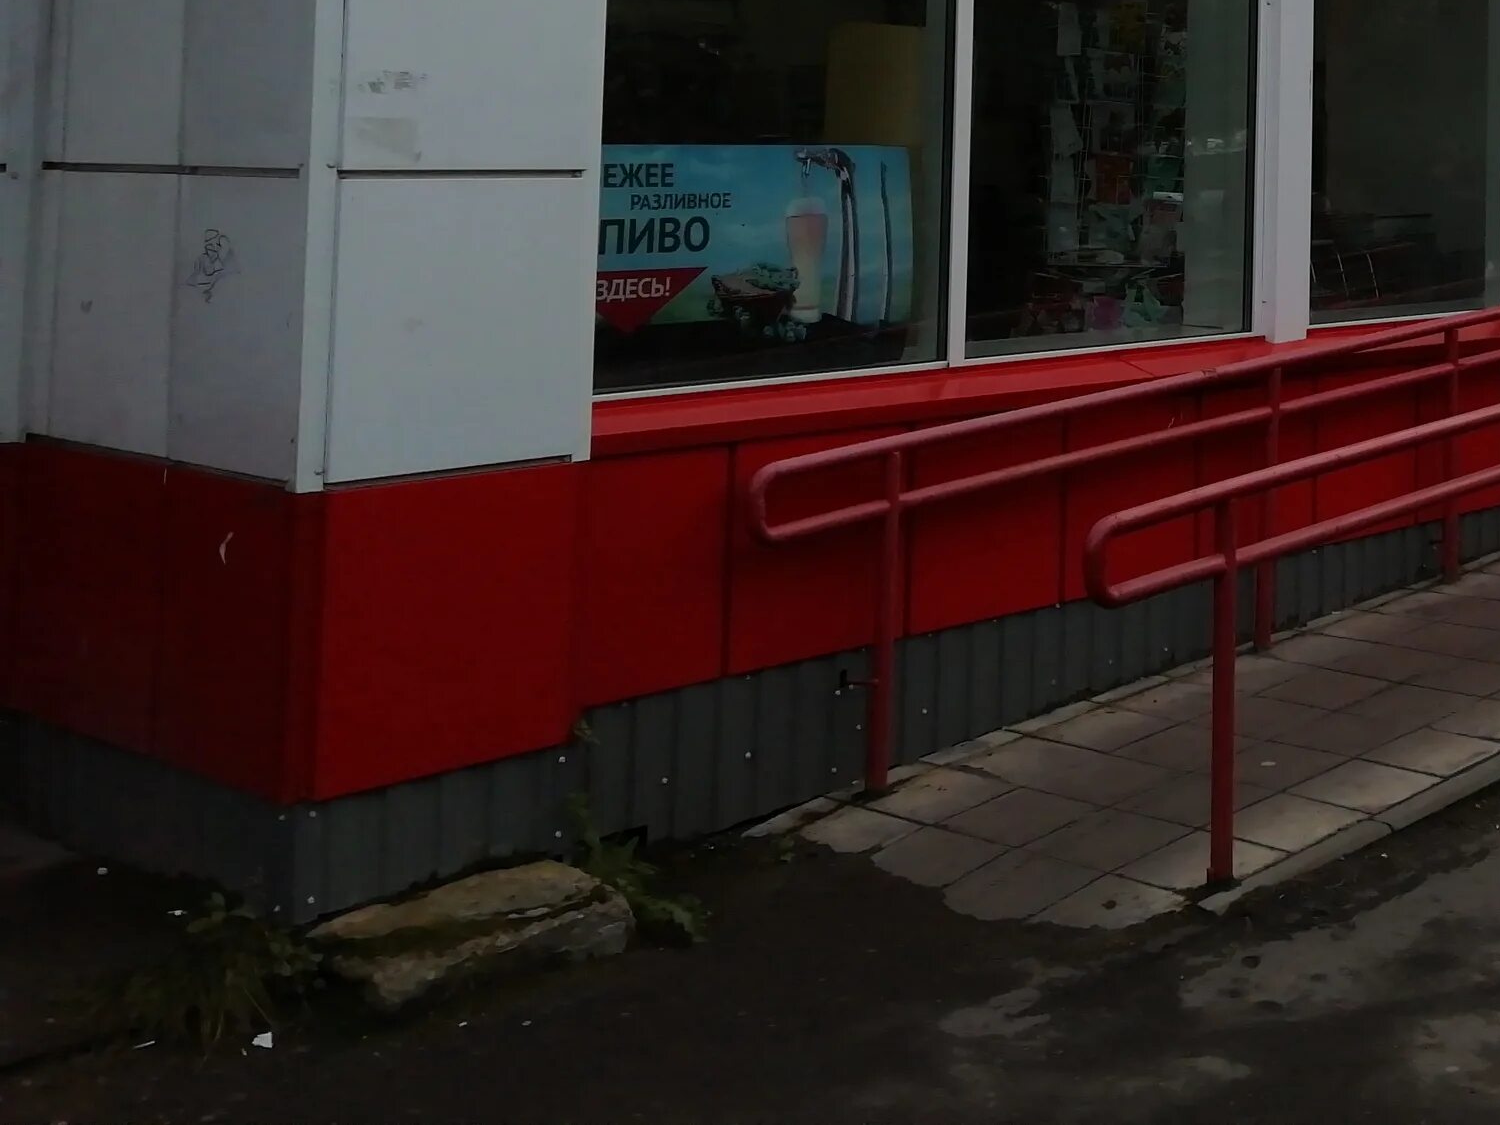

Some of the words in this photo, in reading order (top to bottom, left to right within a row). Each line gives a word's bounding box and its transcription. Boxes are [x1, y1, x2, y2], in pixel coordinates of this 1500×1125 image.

[603, 163, 674, 188] ЕЖЕЕ
[630, 192, 732, 210] РАЗЛИВНОЕ
[598, 216, 710, 255] ПИВО
[596, 276, 672, 303] ЗДЕСЬ!
